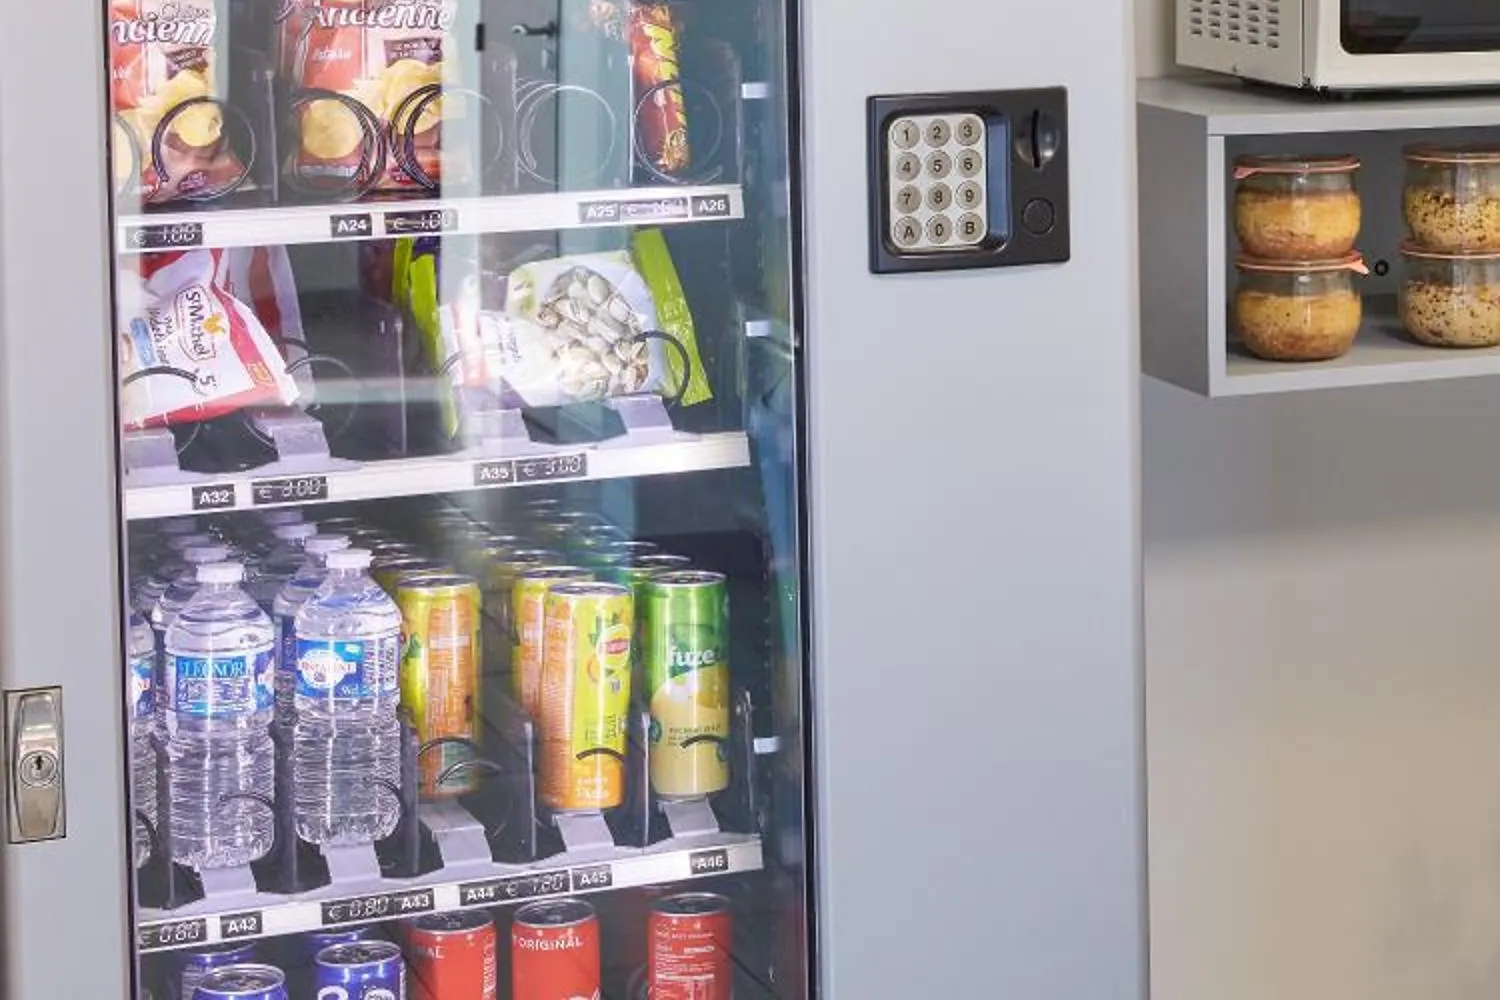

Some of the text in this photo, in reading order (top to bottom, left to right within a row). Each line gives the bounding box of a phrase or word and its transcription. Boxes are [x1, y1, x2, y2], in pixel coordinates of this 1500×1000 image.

[586, 205, 615, 218] A25
[699, 199, 727, 213] A26
[337, 218, 368, 233] A24
[481, 466, 509, 481] A35
[199, 488, 230, 505] A32
[696, 853, 724, 870] A46
[466, 885, 496, 902] A44
[579, 871, 609, 887] A45
[401, 893, 430, 911] A43
[227, 916, 259, 934] A42
